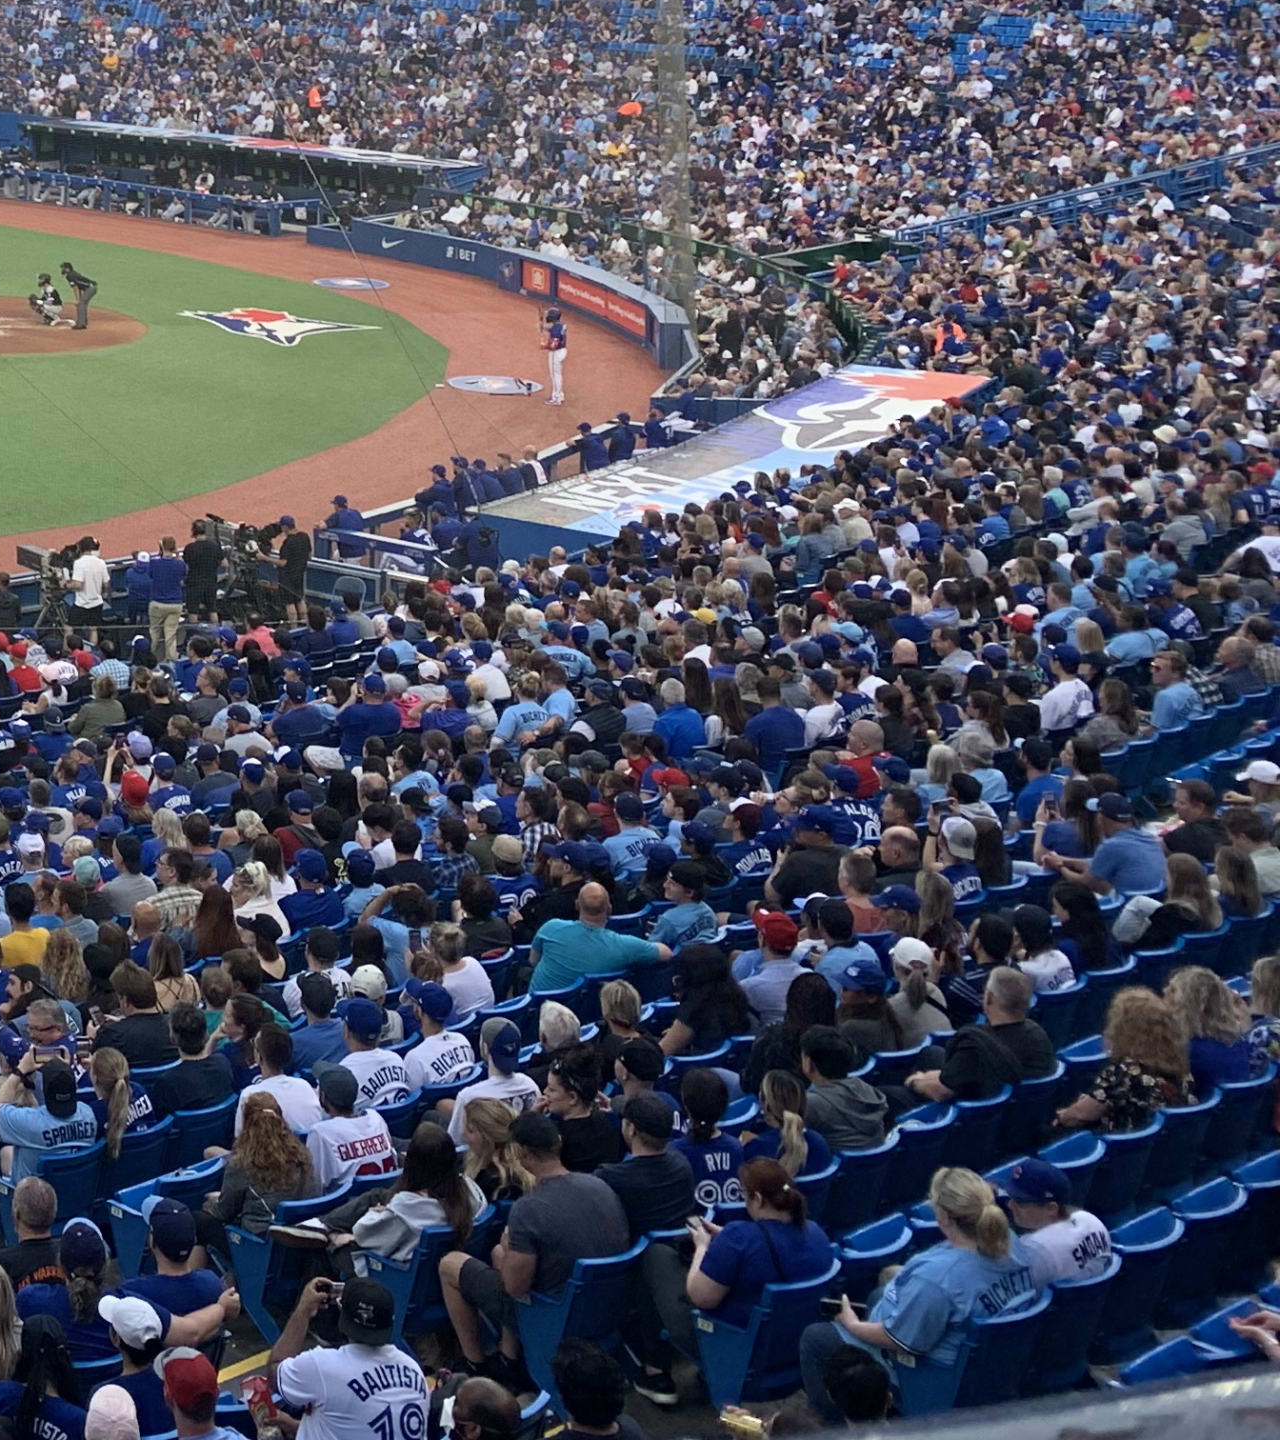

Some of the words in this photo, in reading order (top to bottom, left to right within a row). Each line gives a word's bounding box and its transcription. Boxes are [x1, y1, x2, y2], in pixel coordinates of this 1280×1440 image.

[459, 250, 476, 263] BET
[705, 1152, 730, 1173] RYU
[354, 1363, 428, 1402] BAUTISTA
